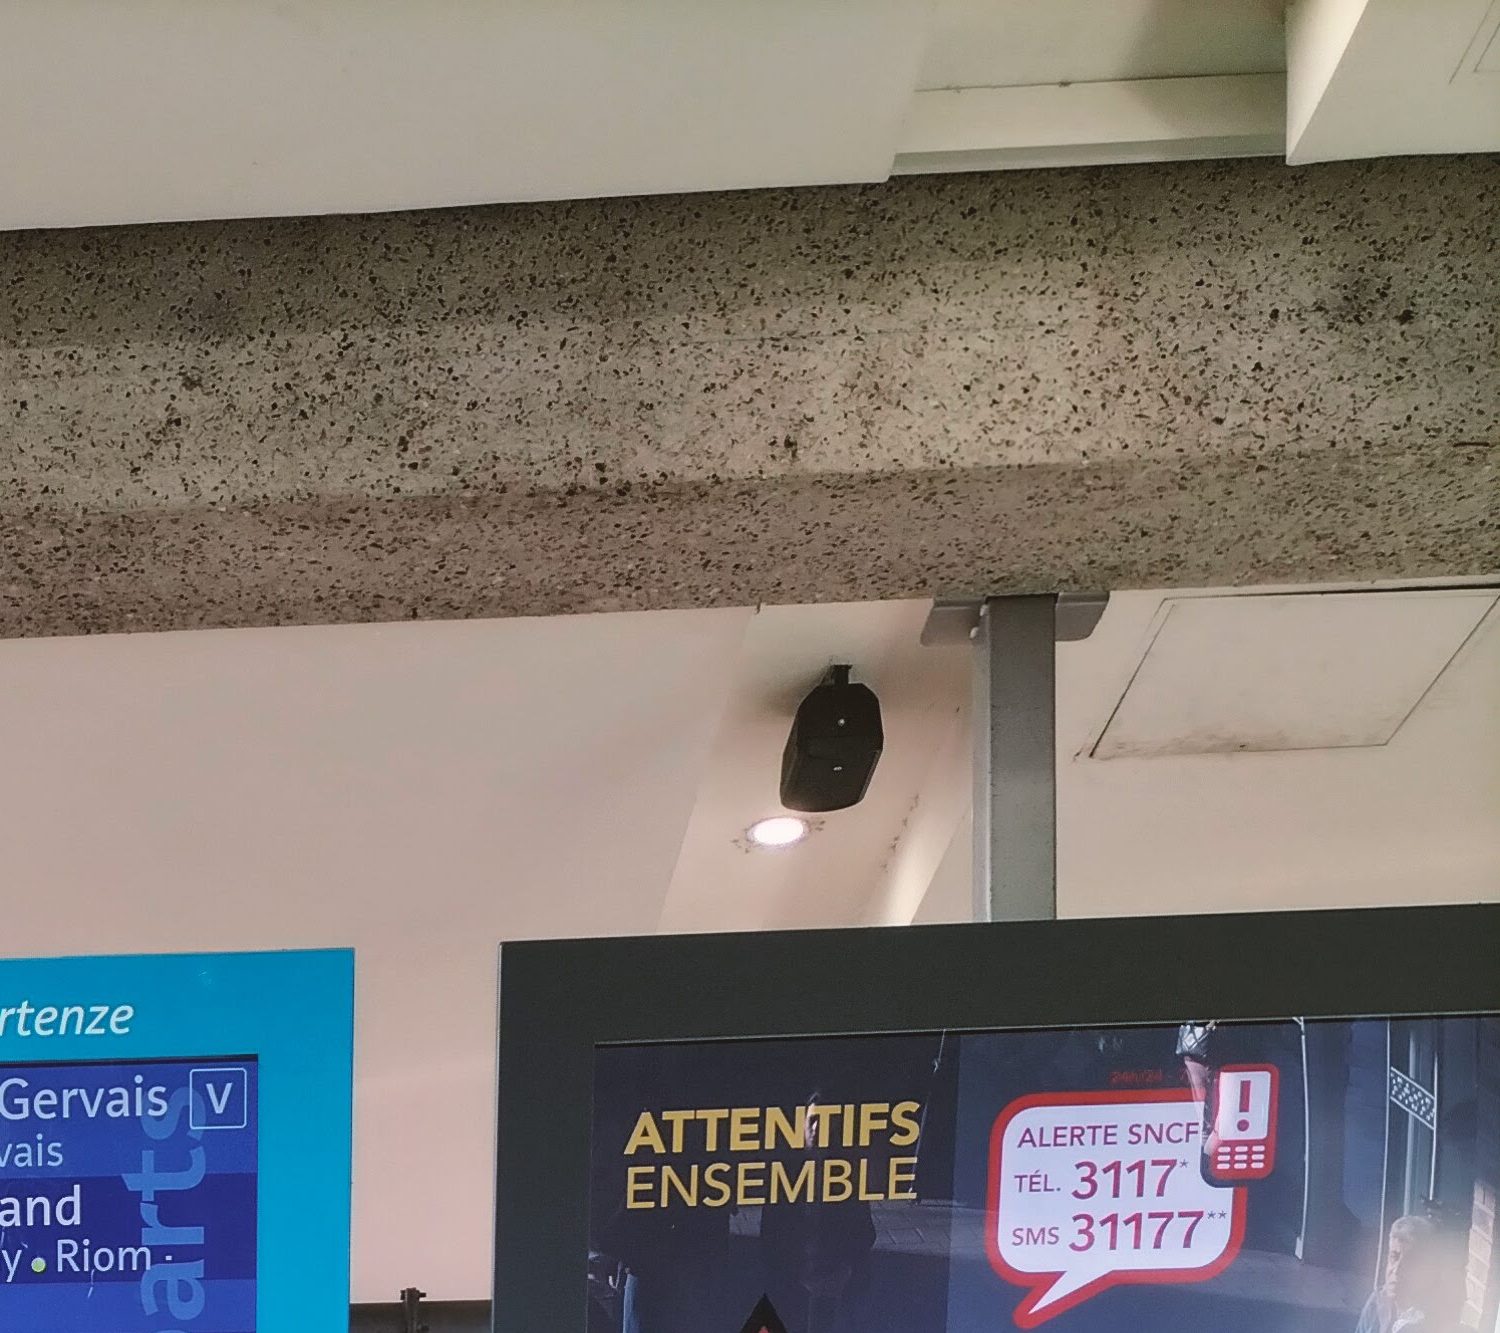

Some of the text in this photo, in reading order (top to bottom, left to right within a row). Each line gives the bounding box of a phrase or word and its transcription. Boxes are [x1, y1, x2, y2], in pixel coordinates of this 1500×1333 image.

[206, 1083, 233, 1114] V
[623, 1101, 920, 1155] ATTENTIFS
[1017, 1121, 1199, 1148] ALERTE SNCF
[626, 1156, 918, 1210] ENSEMBLE
[1014, 1170, 1061, 1193] TÉL.
[1011, 1226, 1060, 1246] SMS
[56, 1237, 151, 1273] Riom
